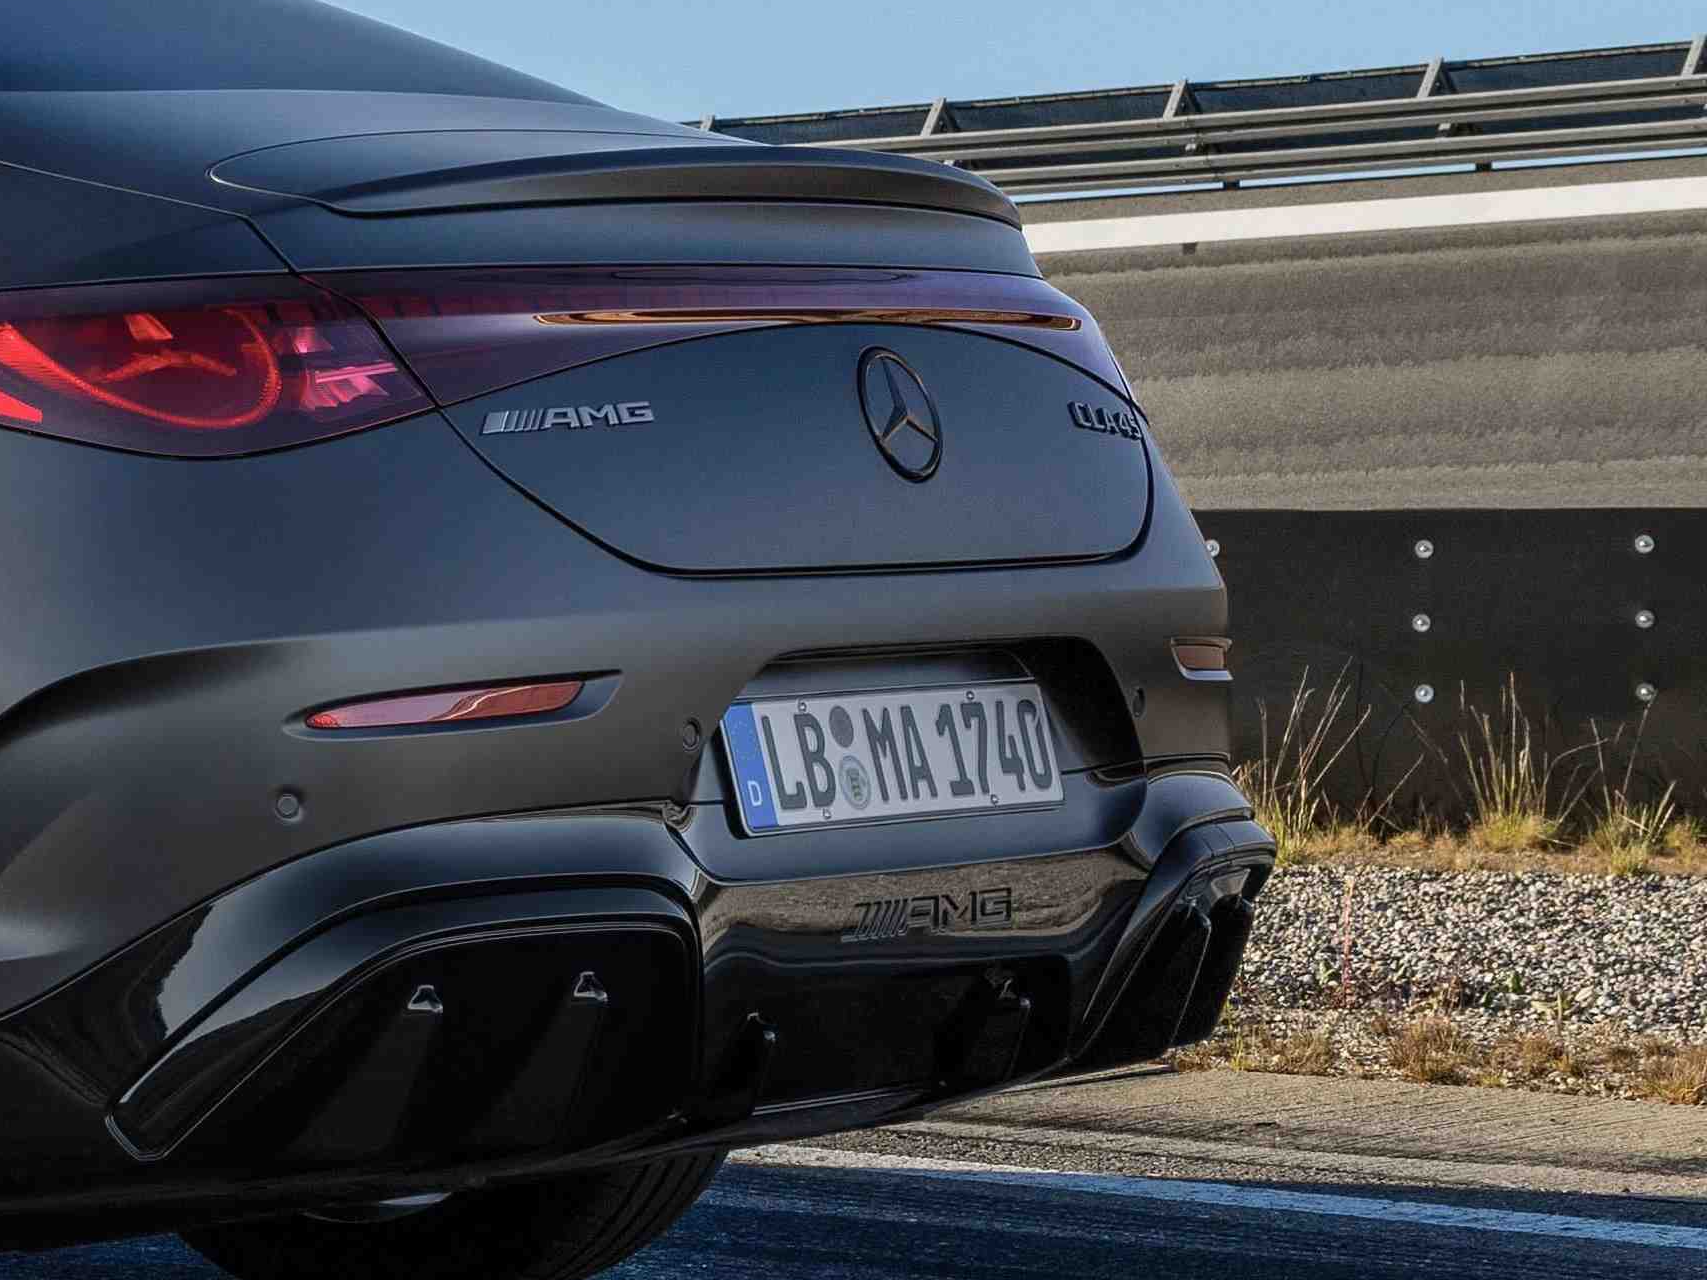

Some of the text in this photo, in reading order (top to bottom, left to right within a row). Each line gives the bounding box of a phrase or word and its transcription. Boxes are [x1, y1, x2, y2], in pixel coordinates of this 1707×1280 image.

[540, 401, 654, 429] AMG
[761, 698, 1054, 810] LB MA 1740
[747, 780, 764, 807] D
[908, 886, 1012, 933] AMG
